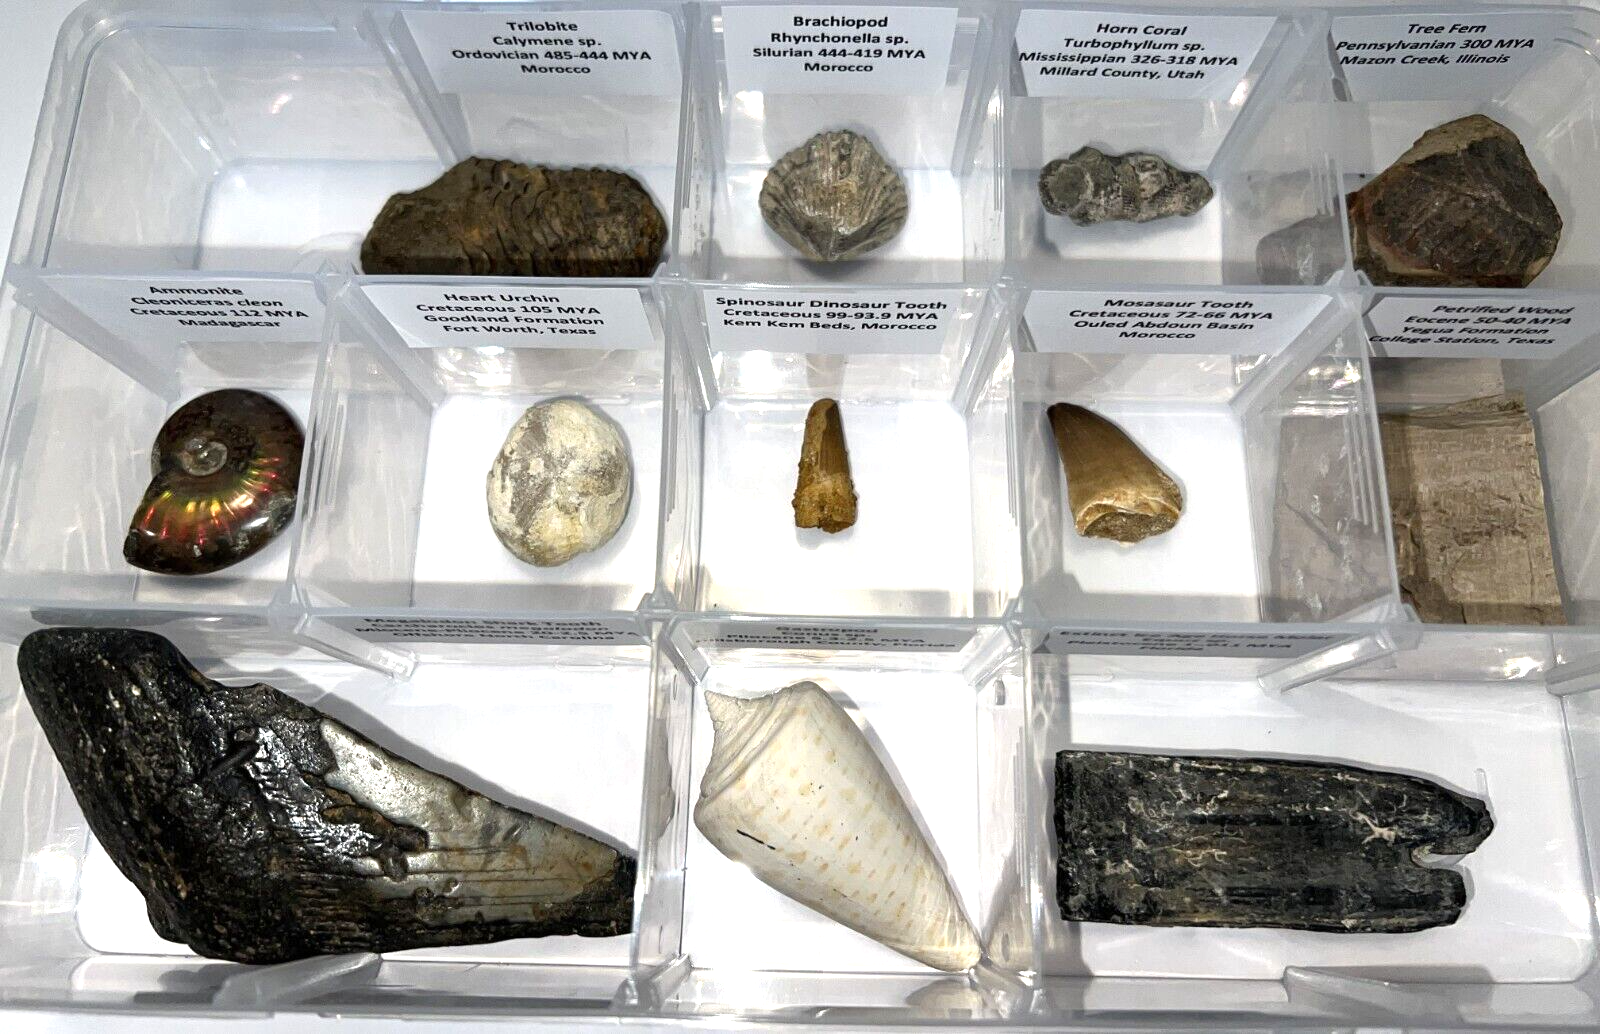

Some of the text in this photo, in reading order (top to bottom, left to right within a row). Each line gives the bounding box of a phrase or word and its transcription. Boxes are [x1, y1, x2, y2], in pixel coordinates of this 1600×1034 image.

[507, 22, 579, 32] Trilobite
[794, 16, 888, 29] Brachiopod
[1097, 24, 1188, 36] Horn Coral
[1408, 24, 1487, 34] Tree Fern
[493, 36, 602, 48] Calymene sp.
[771, 33, 909, 46] Rhynchonella sp.
[1064, 38, 1205, 53] Turbophyllum sp.
[1336, 39, 1535, 53] Pennsylvanian 300 MYA
[452, 50, 652, 61] Ordovician 485-444 MYA
[753, 48, 926, 59] Silurian 444-419 MYA
[1019, 52, 1238, 66] Mississippian 326-318 MYA
[1340, 54, 1511, 65] Mazon Creek, Illinois
[521, 65, 591, 74] Morocco
[804, 63, 874, 72] Morocco
[1040, 67, 1205, 80] Millard County, Utah
[149, 287, 244, 295] Ammonite
[131, 298, 284, 307] Cleoniceras cleon
[444, 294, 560, 303] Heart Urchin
[716, 298, 947, 310] Spinosaur Dinosaur Tooth
[1104, 300, 1196, 308] Mosasaur
[130, 308, 228, 317] Cretaceous
[416, 305, 601, 314] Cretaceous 105 MYA
[724, 309, 821, 319] Cretaceous
[826, 312, 891, 320] 99-93.9
[1432, 306, 1576, 315] Petrified Wood
[424, 315, 604, 325] Goodland Formation
[1069, 310, 1273, 320] Cretaceous 72-66 MYA
[1404, 316, 1471, 324] Eocene
[179, 319, 281, 328] Madagascar
[810, 322, 856, 330] Beds,
[1131, 321, 1203, 329] Abdoun
[483, 326, 544, 335] Worth,
[551, 327, 597, 335] Texas
[1402, 327, 1550, 335] Yegua Formation
[1369, 336, 1556, 345] College Station, Texas
